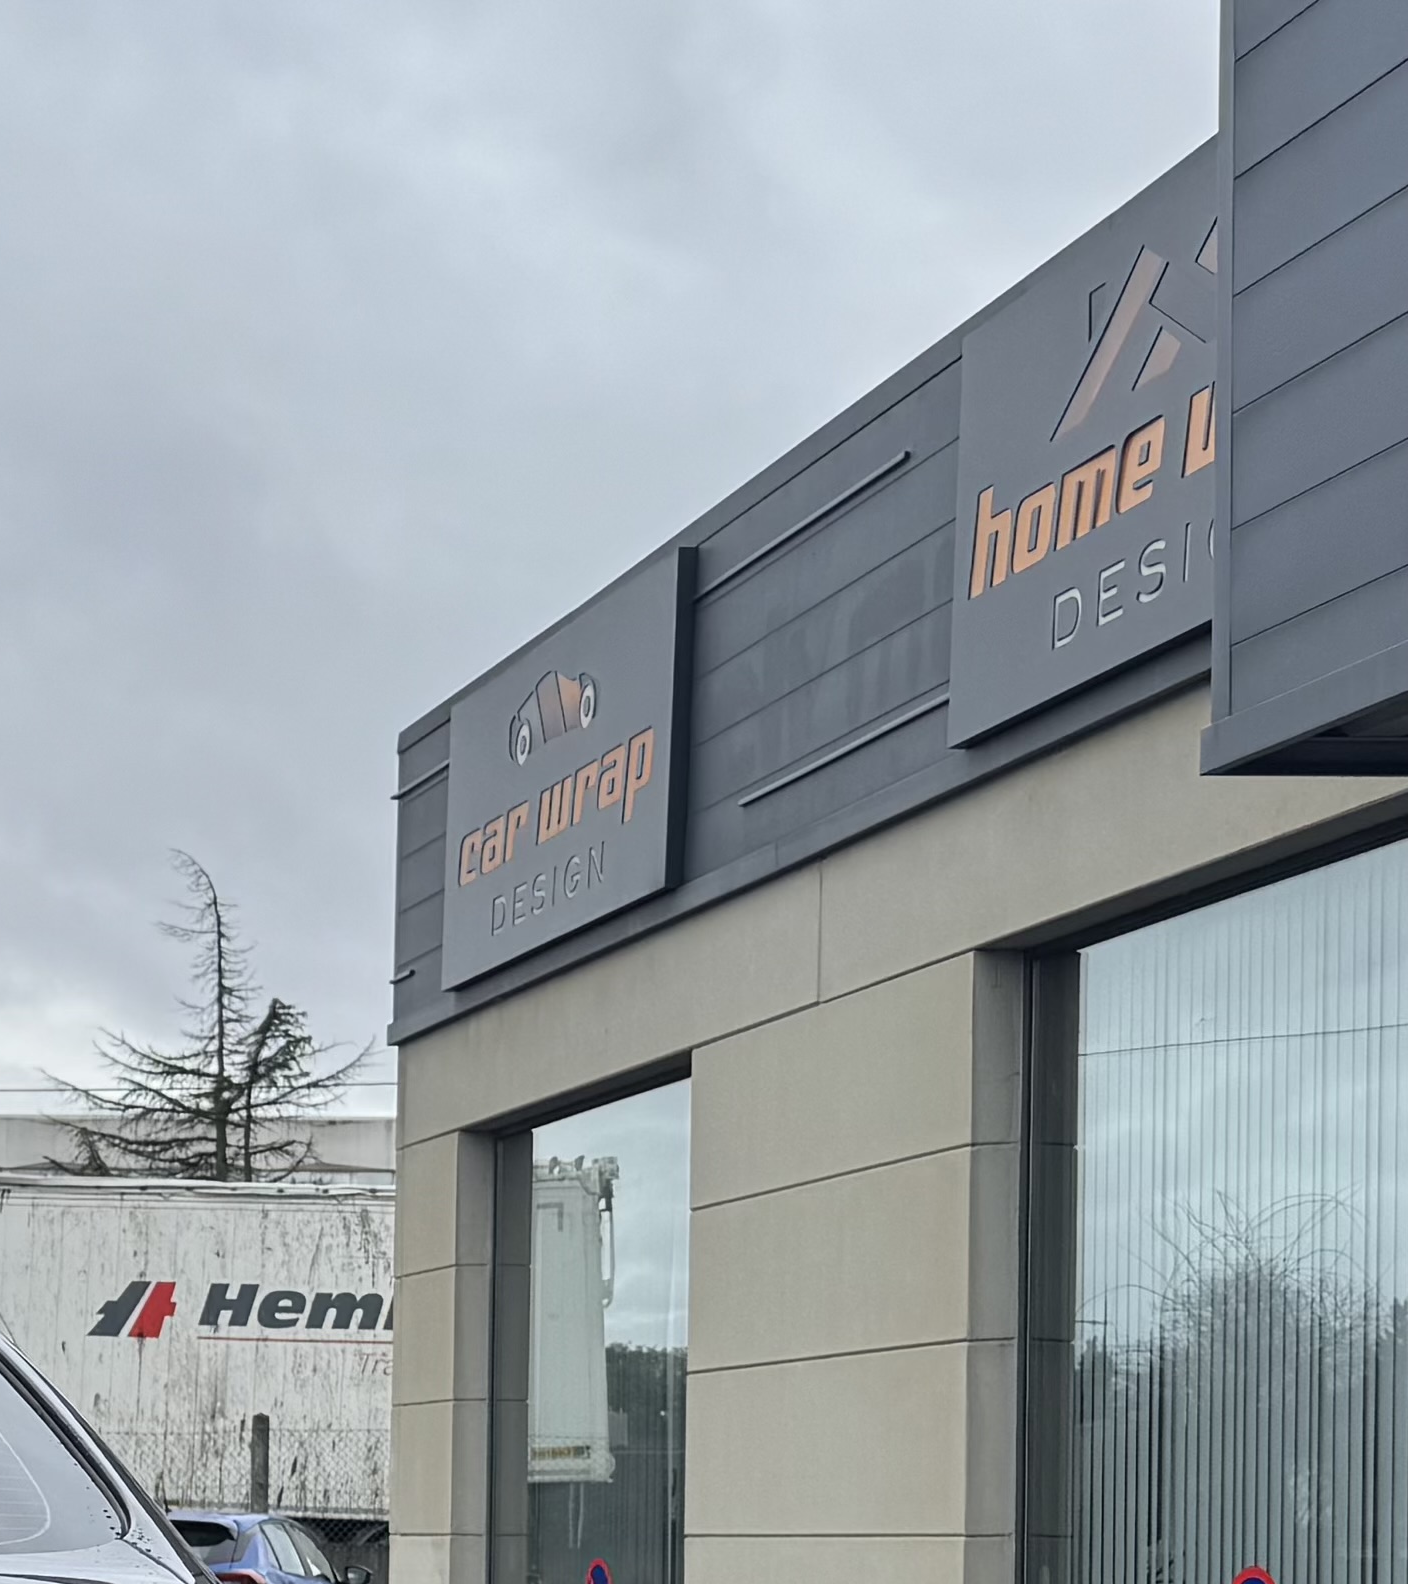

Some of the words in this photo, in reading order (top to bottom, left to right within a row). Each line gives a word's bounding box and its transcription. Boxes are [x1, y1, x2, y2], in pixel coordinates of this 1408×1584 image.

[969, 414, 1166, 601] home
[1052, 518, 1215, 650] DESI
[458, 800, 530, 887] car
[535, 725, 654, 846] wrap
[491, 840, 605, 937] DESIGN
[198, 1282, 394, 1331] Hem
